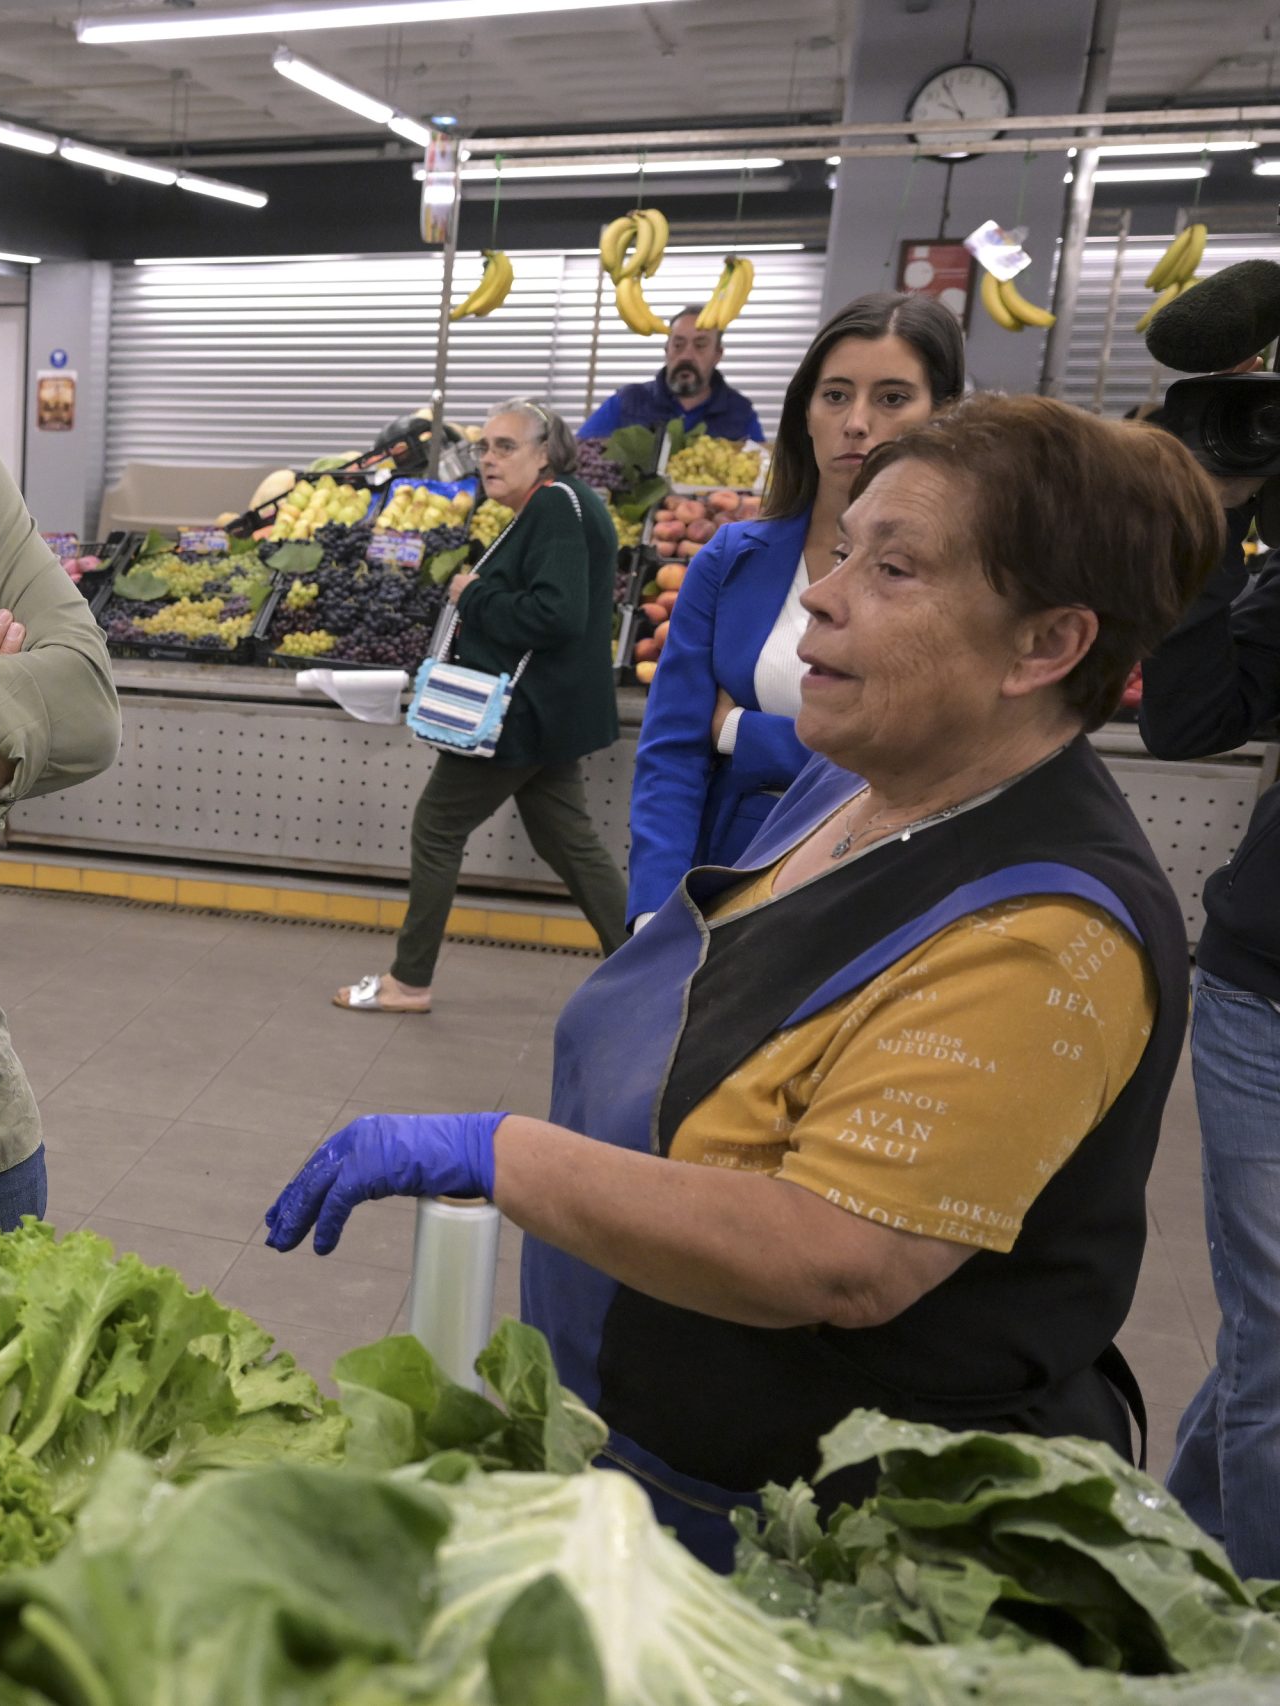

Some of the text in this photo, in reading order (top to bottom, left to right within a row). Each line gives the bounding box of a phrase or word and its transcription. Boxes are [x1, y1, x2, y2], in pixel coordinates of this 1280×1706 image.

[1058, 917, 1105, 967] BNO
[1072, 938, 1117, 981] VBO
[877, 1038, 998, 1073] MJEUDNAA
[900, 1028, 963, 1049] NUEDS
[1051, 1039, 1083, 1061] OS
[882, 1087, 949, 1116] BNOE
[846, 1107, 934, 1142] AVAN
[836, 1128, 919, 1164] DKUI
